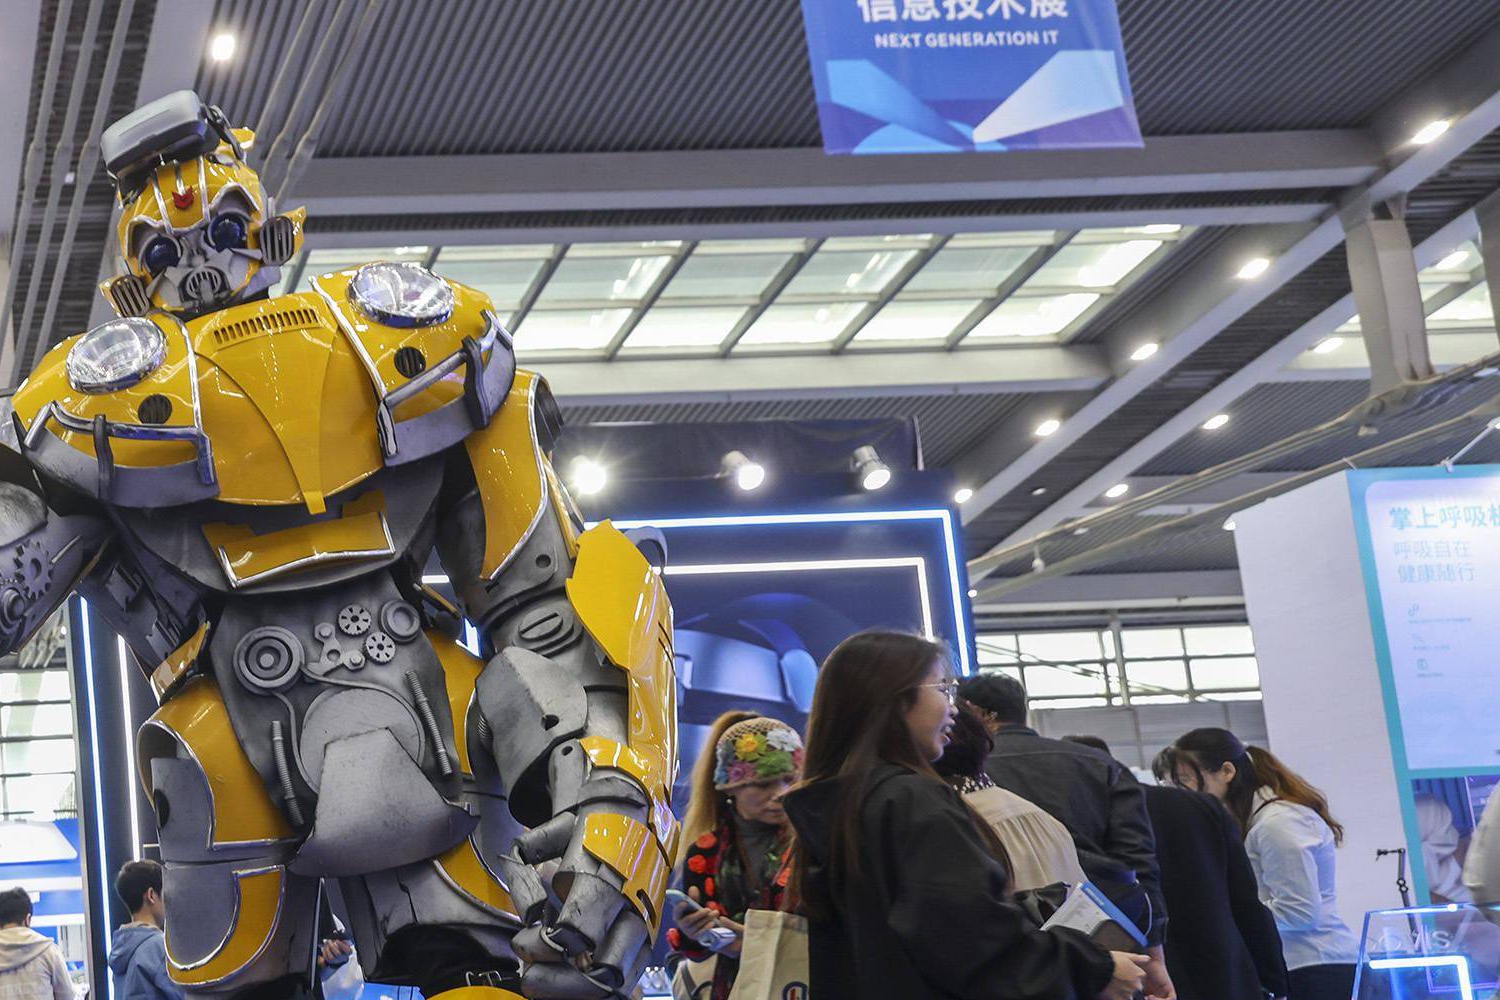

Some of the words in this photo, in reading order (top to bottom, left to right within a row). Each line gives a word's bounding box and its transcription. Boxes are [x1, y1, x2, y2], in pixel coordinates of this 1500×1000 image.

[874, 33, 921, 48] NEXT
[925, 30, 1039, 47] GENERATION
[1042, 29, 1059, 45] IT
